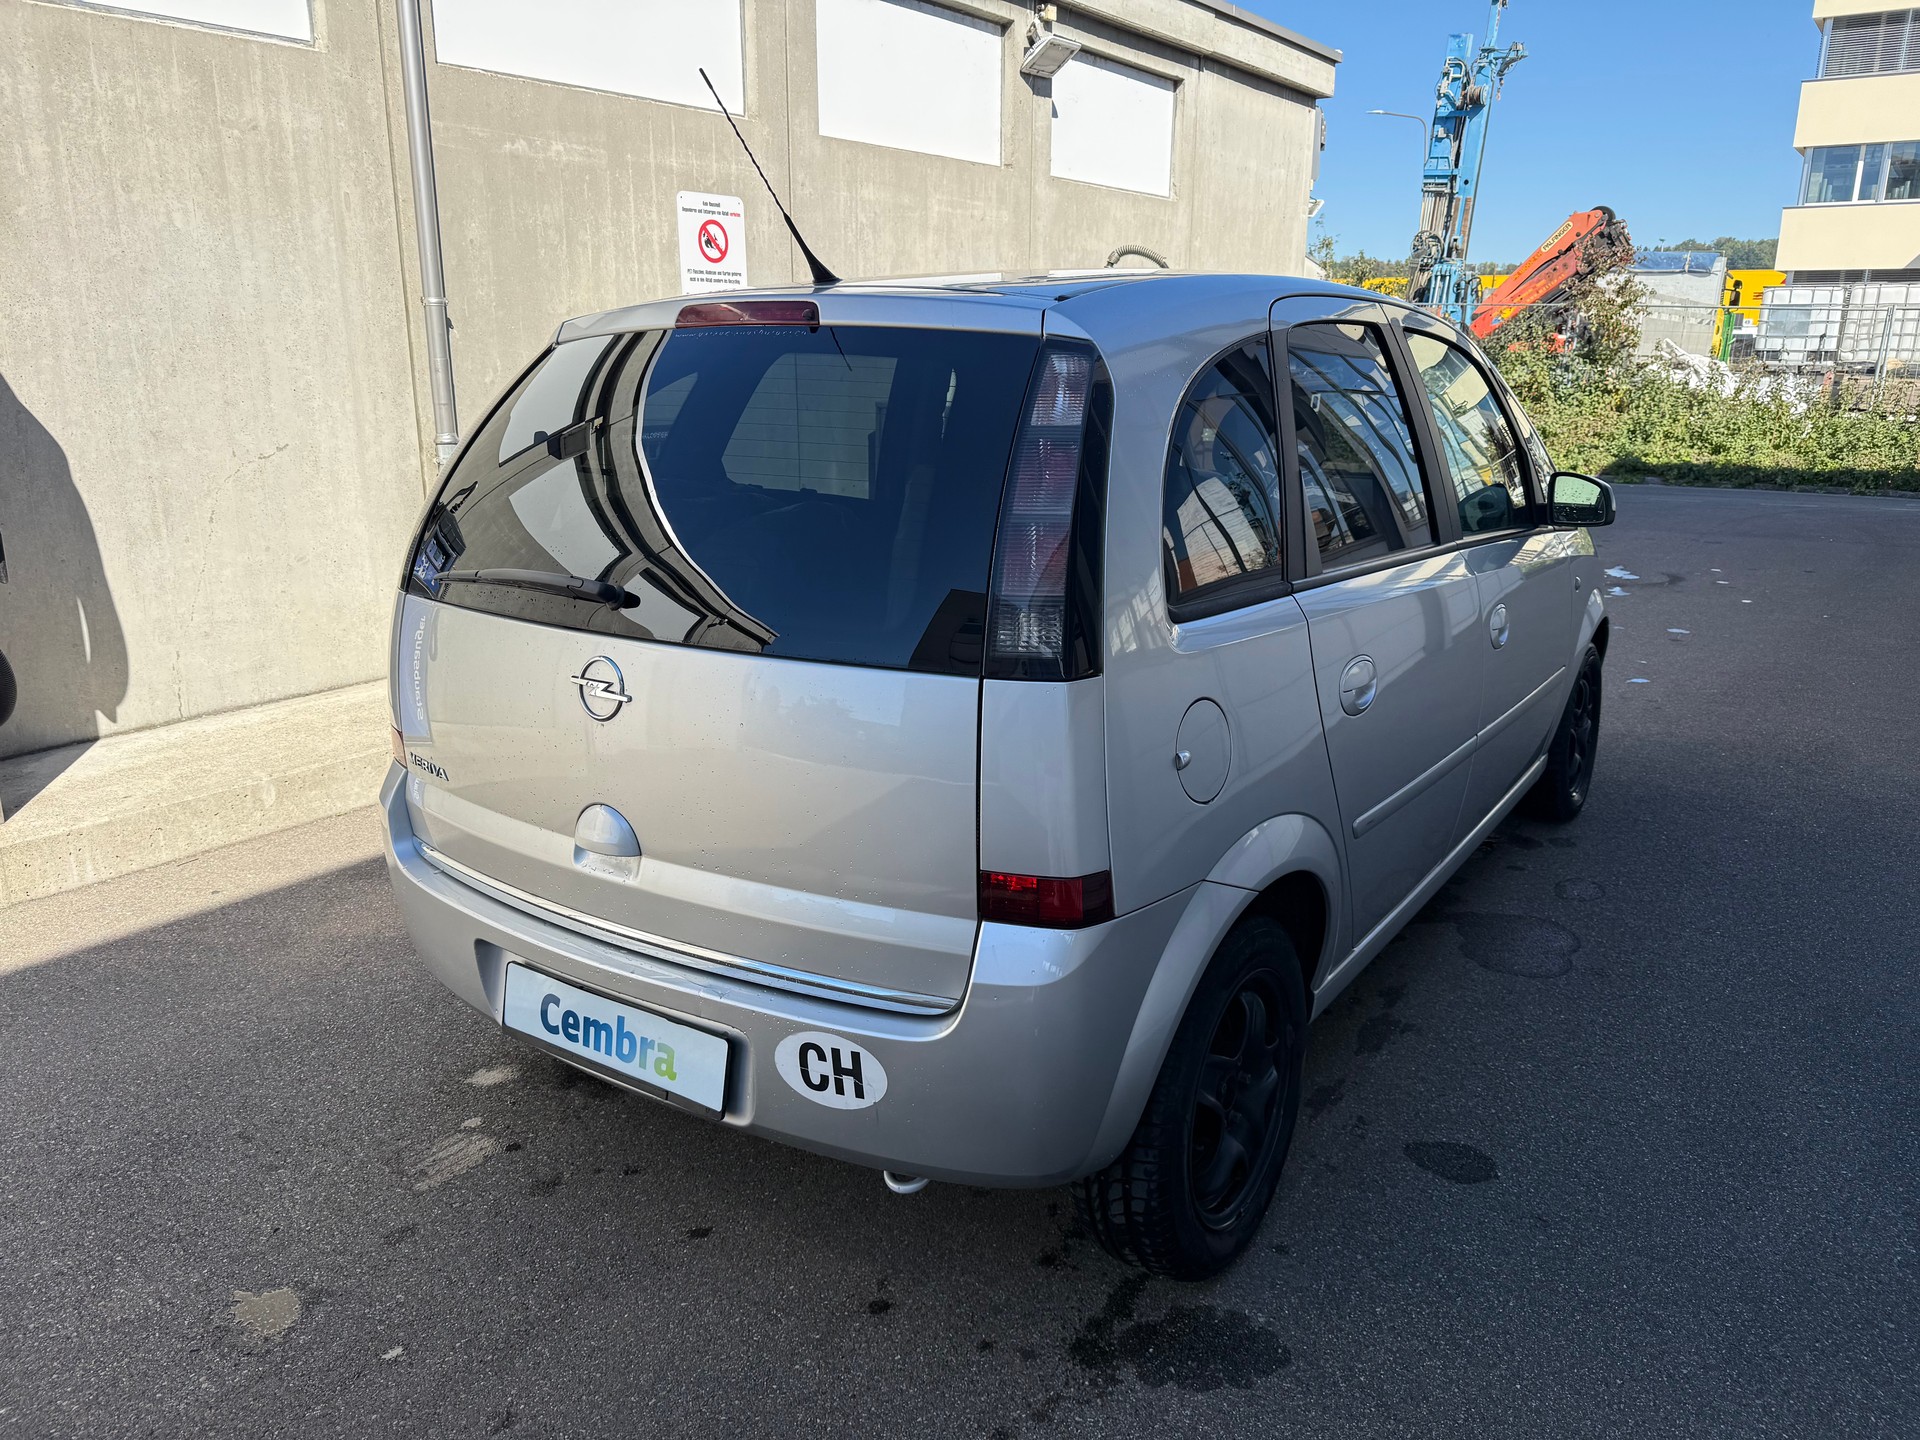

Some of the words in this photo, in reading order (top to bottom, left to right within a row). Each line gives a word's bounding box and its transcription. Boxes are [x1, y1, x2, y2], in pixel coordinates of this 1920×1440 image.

[1543, 223, 1572, 251] PALFINGER
[540, 993, 678, 1082] Cembra
[799, 1041, 865, 1100] CH
